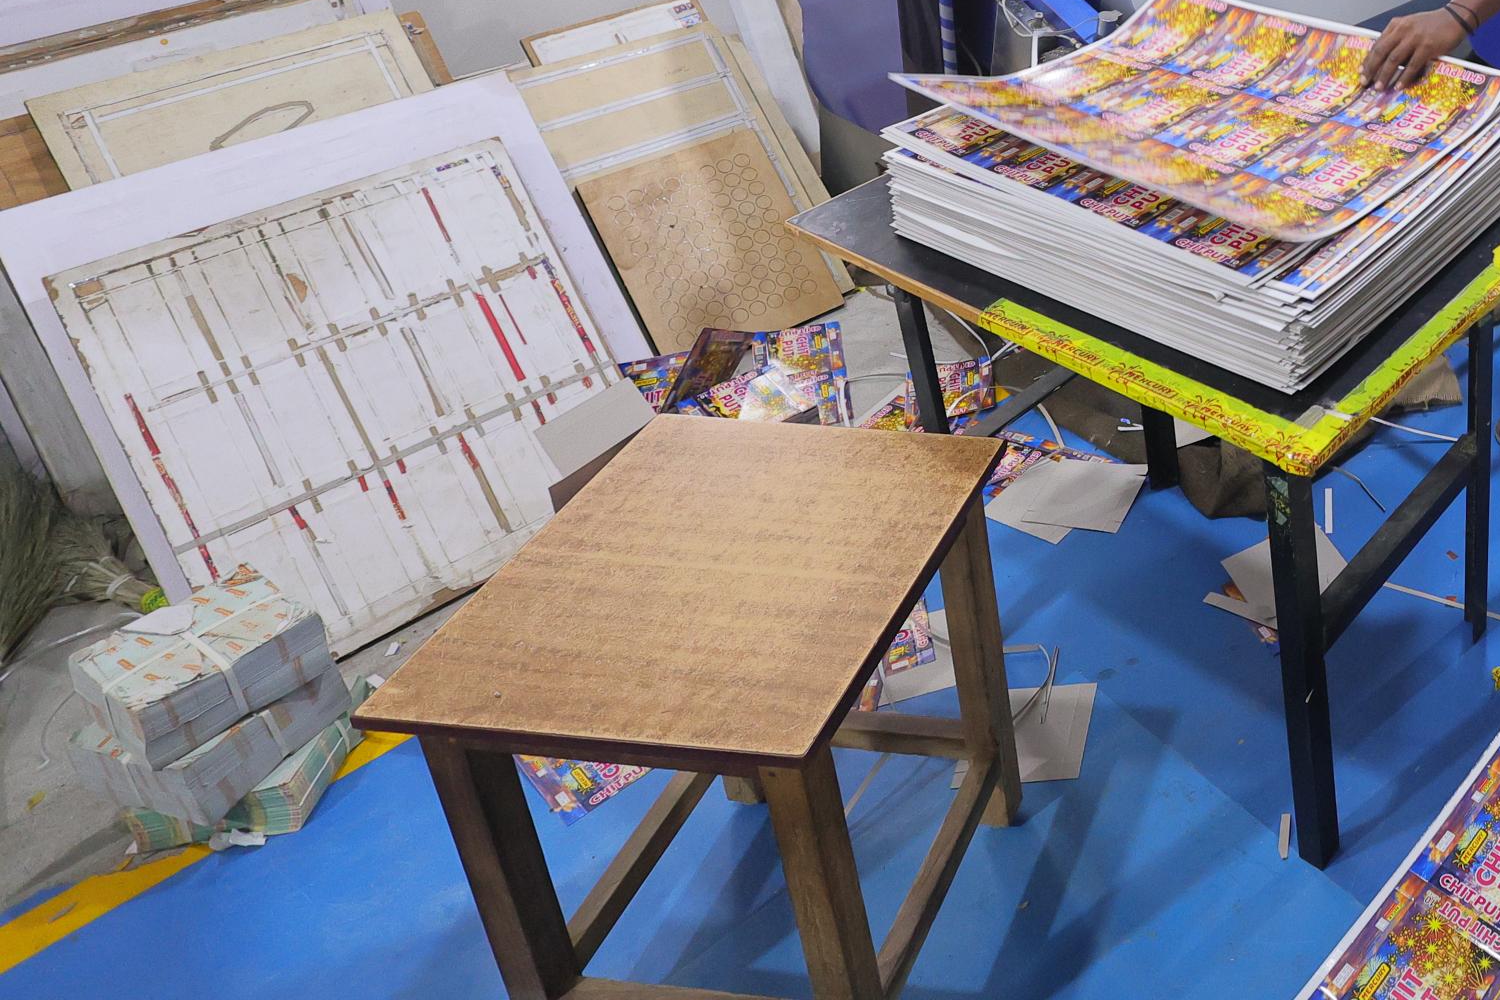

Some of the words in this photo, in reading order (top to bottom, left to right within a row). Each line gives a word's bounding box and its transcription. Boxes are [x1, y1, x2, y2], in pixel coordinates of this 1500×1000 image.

[1219, 51, 1251, 77] CHIT
[1437, 62, 1464, 78] PUT
[1460, 68, 1487, 85] CHIT
[1304, 74, 1336, 102] CHIT
[1322, 81, 1350, 106] PUT
[1396, 103, 1430, 131] CHIT
[1418, 109, 1444, 132] PUT
[1218, 125, 1255, 149] CHIT
[1236, 132, 1270, 153] PUT
[1314, 158, 1350, 183] CHIT
[1333, 165, 1366, 188] PUT
[1079, 198, 1110, 215] CHIT
[1107, 206, 1131, 223] PUT
[1175, 238, 1205, 255] CHIT
[1202, 246, 1230, 263] PUT
[1051, 339, 1100, 362] MERCURY
[1124, 369, 1174, 399] MERCURY
[588, 781, 624, 806] CHIT
[623, 766, 644, 782] PU
[1460, 829, 1488, 864] MERCURY
[1440, 874, 1478, 905] CHIT
[1438, 900, 1474, 930] PUT
